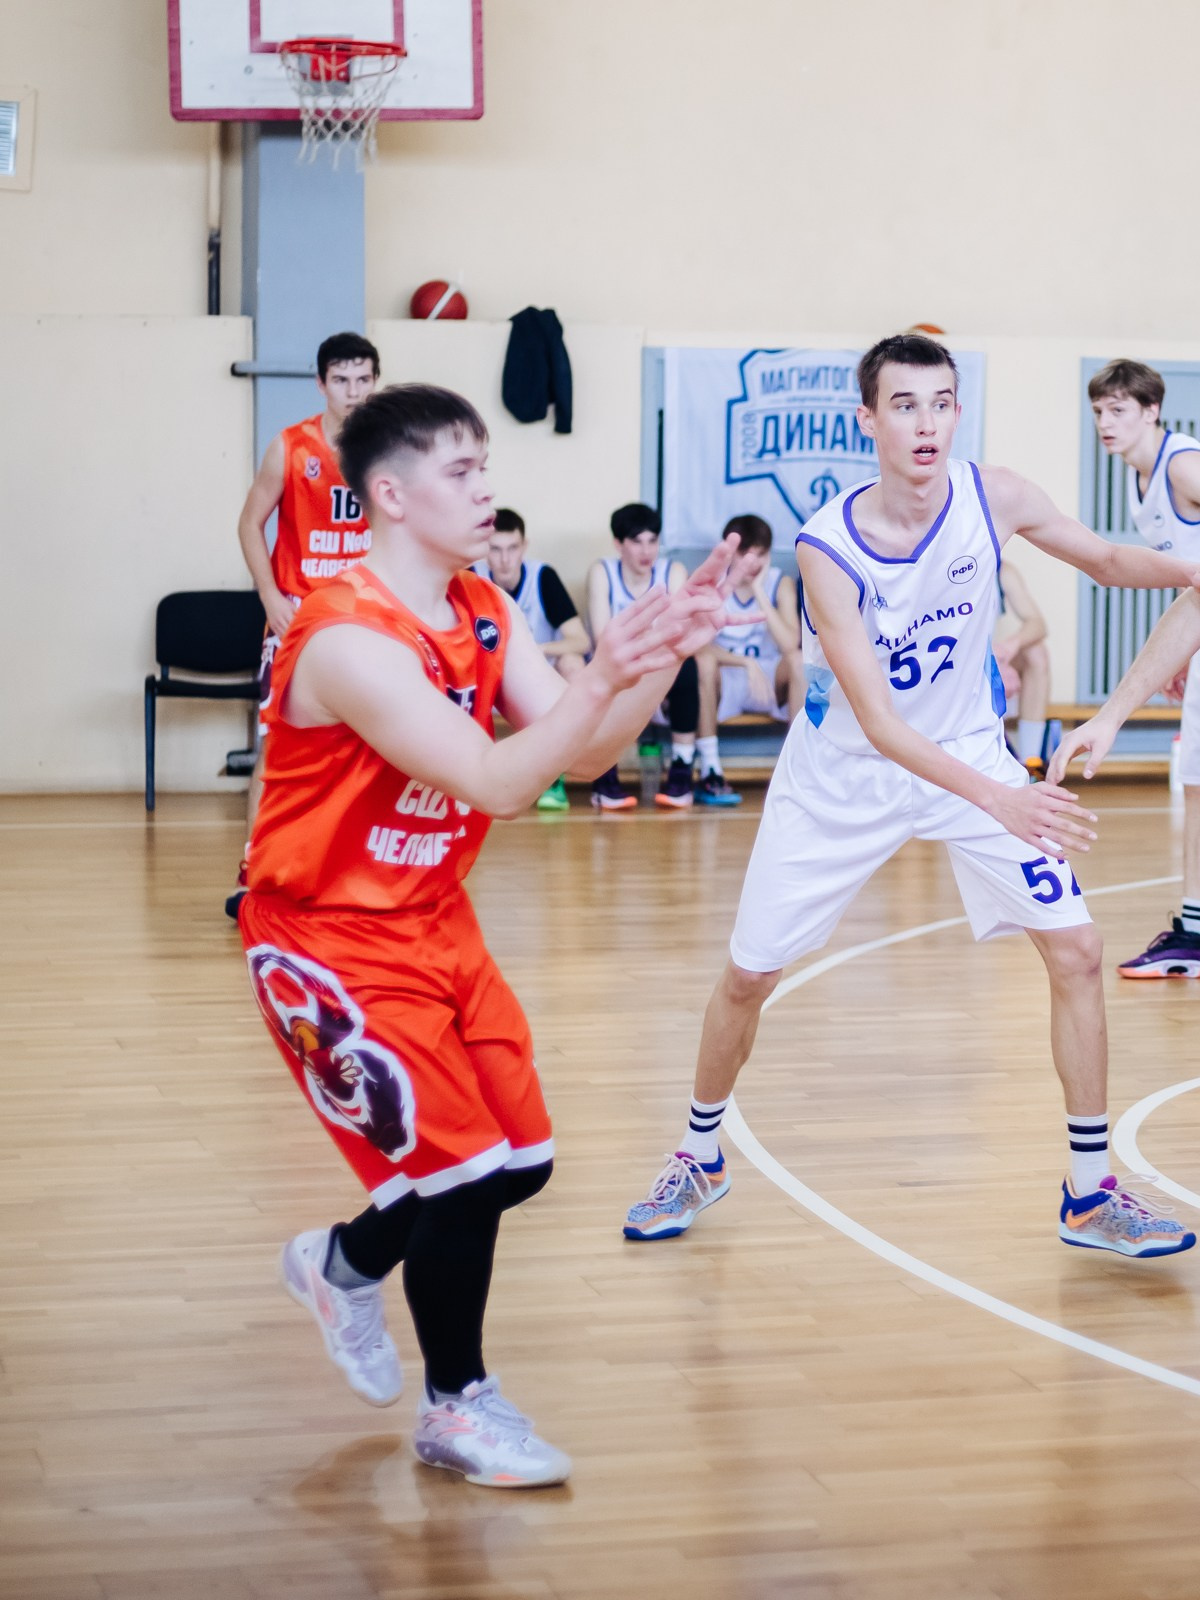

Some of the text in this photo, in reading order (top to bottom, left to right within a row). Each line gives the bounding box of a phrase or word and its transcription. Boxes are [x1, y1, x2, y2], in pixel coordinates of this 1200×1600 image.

[756, 412, 875, 459] ДИНАМ
[330, 485, 363, 523] 16
[309, 529, 341, 555] СШ
[951, 562, 974, 579] РФБ
[875, 602, 974, 651] ДИНАМО
[889, 635, 959, 691] 52
[395, 778, 449, 821] СШ
